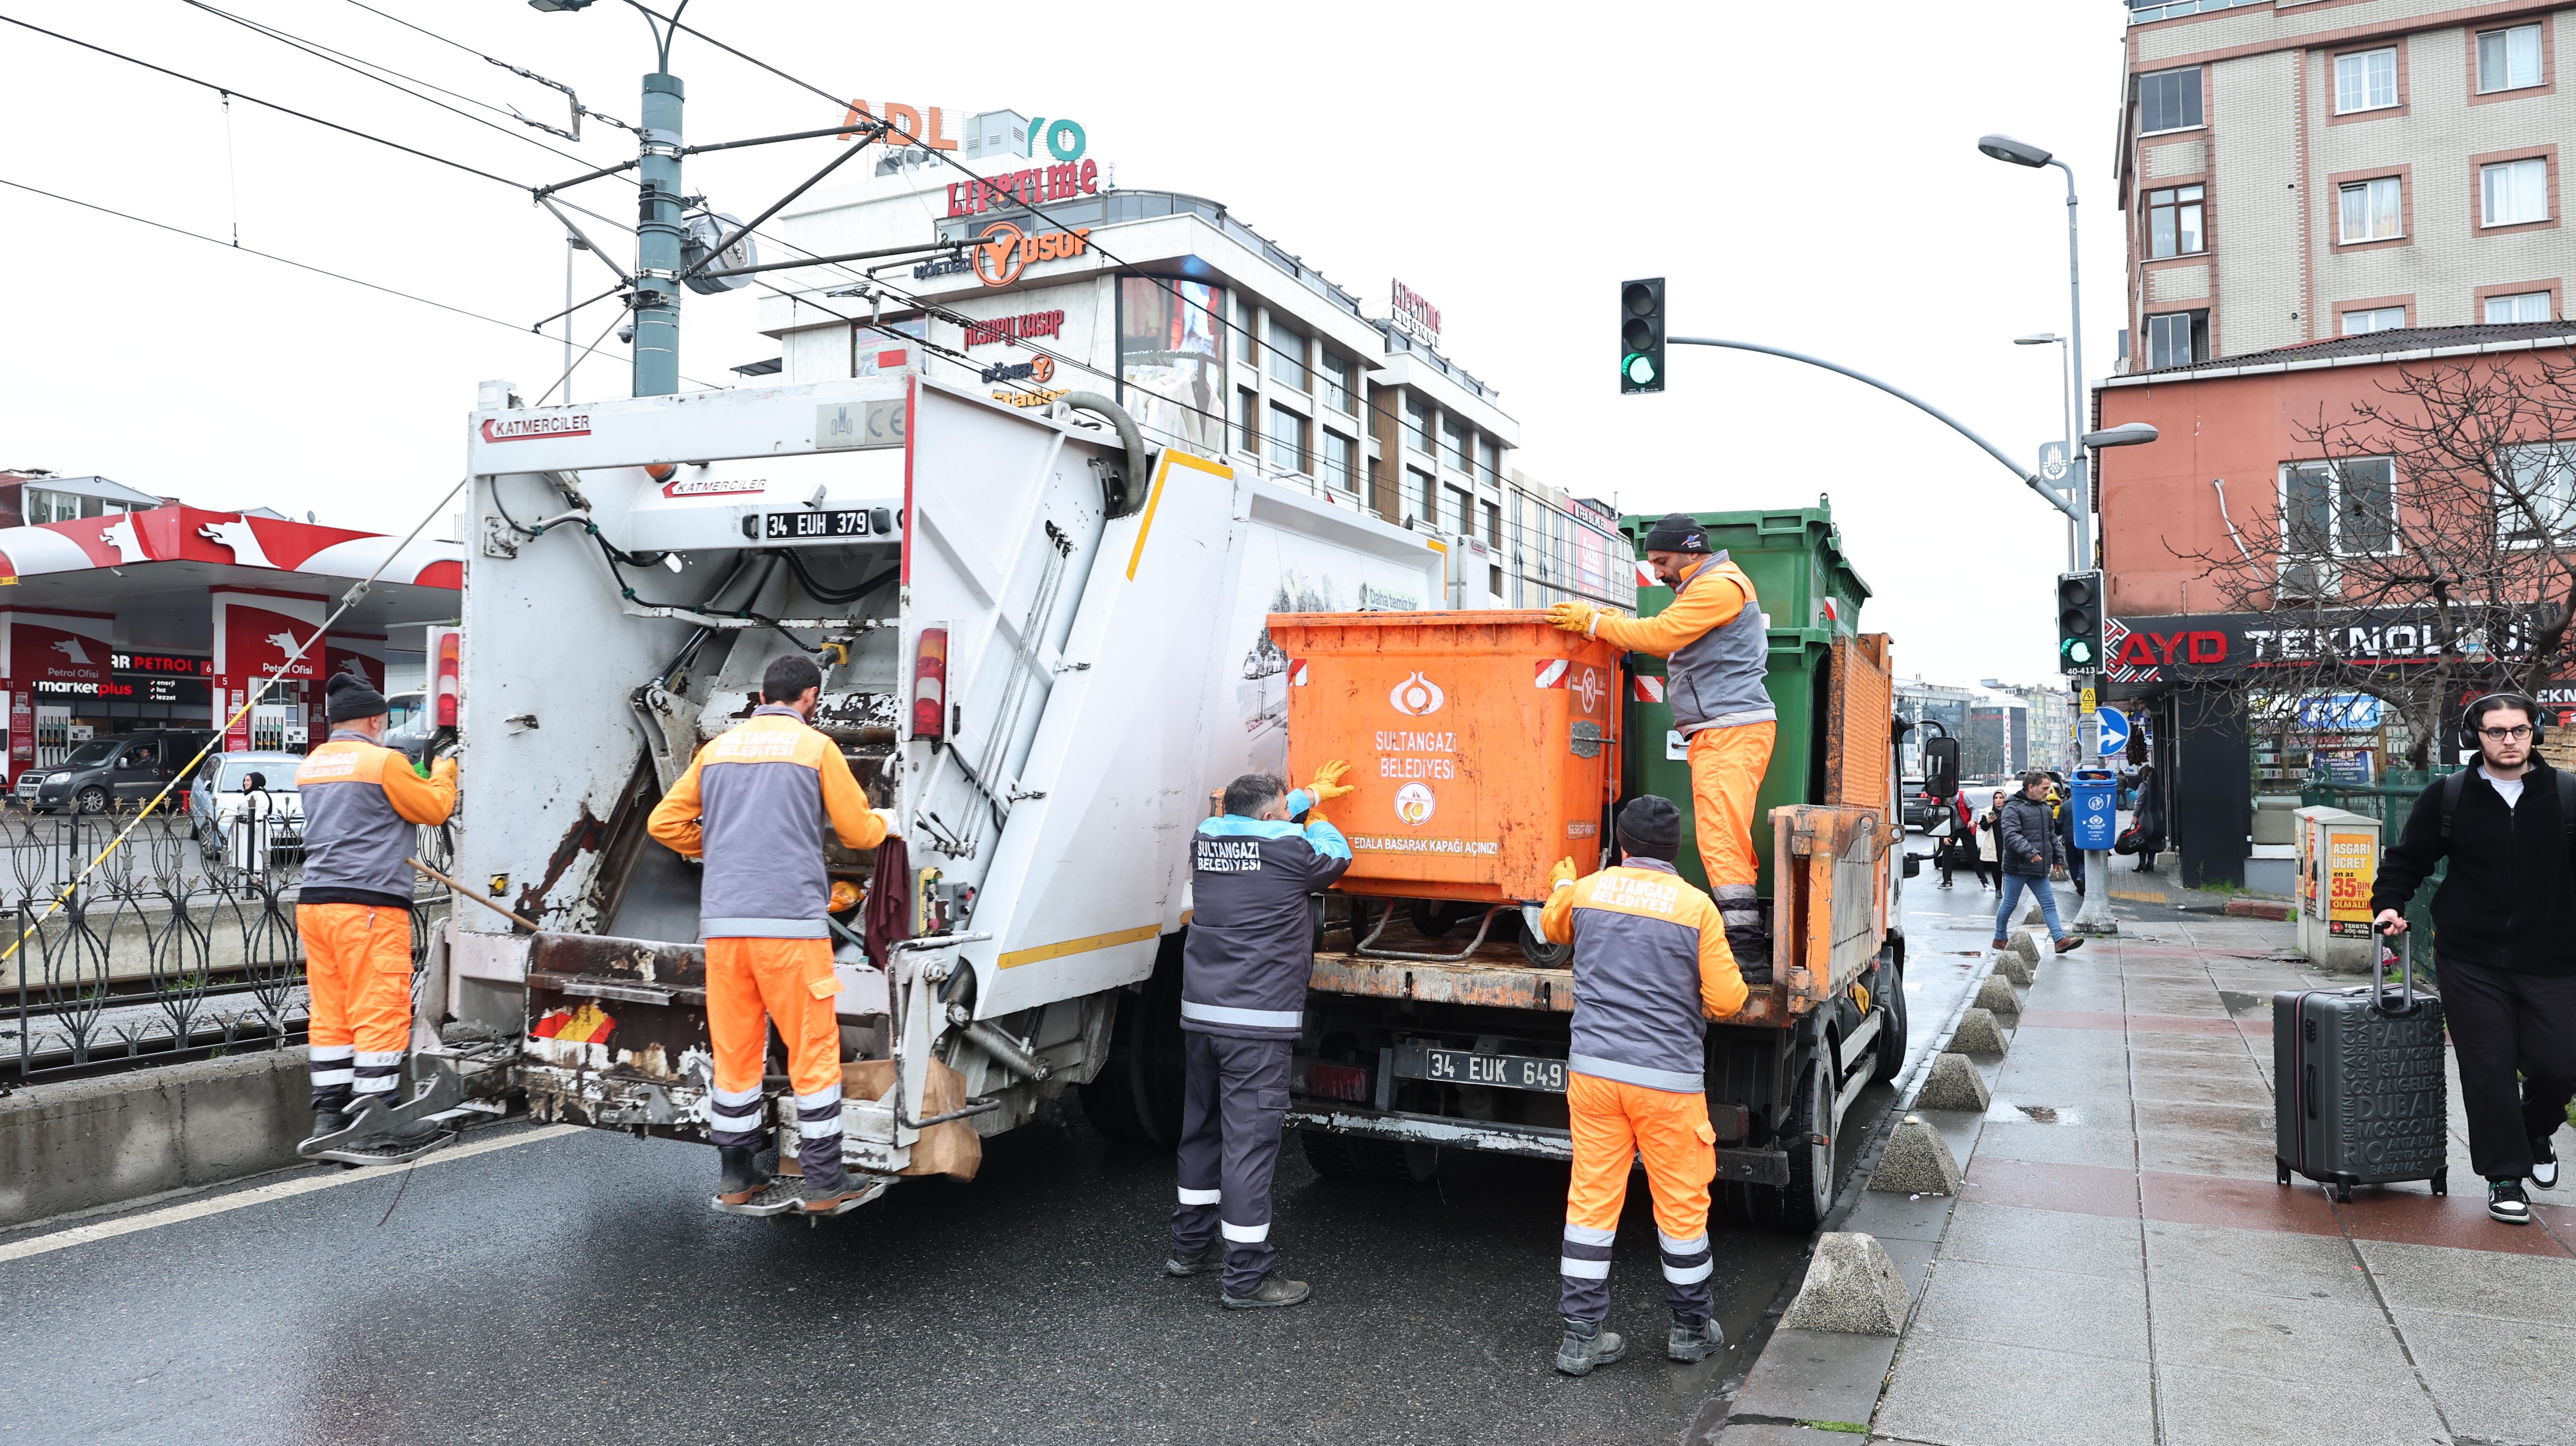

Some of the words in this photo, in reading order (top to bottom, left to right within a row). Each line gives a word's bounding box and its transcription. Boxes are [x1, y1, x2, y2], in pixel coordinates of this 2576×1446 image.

[837, 99, 957, 150] ADL
[983, 227, 1090, 277] YUSUF
[1018, 309, 1064, 339] KASAP
[768, 514, 788, 537] 34
[797, 512, 827, 535] EUH
[837, 510, 867, 533] 379
[1579, 507, 1588, 522] FEN
[1370, 588, 1388, 608] Daha
[1389, 594, 1408, 610] temiz
[1408, 597, 1418, 611] bir
[2117, 630, 2227, 665] AYD
[48, 667, 75, 677] Petrol
[77, 668, 99, 678] Ofisi
[111, 654, 130, 669] AR
[134, 656, 194, 673] PETROL
[206, 664, 211, 673] 6
[263, 662, 290, 674] Petrl
[291, 665, 313, 675] Ofisi
[2067, 667, 2096, 675] 40-413
[6, 680, 14, 688] 11
[156, 679, 176, 688] enerji
[222, 677, 228, 686] 5
[292, 683, 298, 691] 10
[2536, 689, 2576, 703] EKN
[1349, 836, 1383, 850] EDALA
[1385, 838, 1427, 852] BASARAK
[1429, 838, 1463, 853] KAPAĞI
[1466, 840, 1497, 857] AÇINIZ!
[2333, 841, 2371, 855] ASGARİ
[2332, 856, 2367, 869] ÜCRET
[2331, 877, 2357, 898] 35
[2357, 880, 2370, 890] BİN
[2357, 890, 2366, 898] TL
[2333, 900, 2368, 909] OLMALI!
[2371, 1019, 2433, 1049] PARIS
[2342, 1010, 2356, 1080] CANCUN
[2358, 1023, 2369, 1079] FLORIDA
[2371, 1048, 2399, 1063] NEW
[2402, 1046, 2434, 1061] YORK
[1431, 1054, 1456, 1078] 34
[1469, 1056, 1507, 1083] EUK
[1522, 1062, 1562, 1088] 649
[2342, 1080, 2371, 1096] LOS
[2375, 1075, 2437, 1094] ANGELES
[2358, 1091, 2435, 1121] DUBAI
[2342, 1096, 2355, 1142] BERLIN
[2357, 1116, 2437, 1140] MOSCOW
[2386, 1135, 2436, 1150] ANTALYA
[2342, 1140, 2384, 1166] RIO
[2388, 1150, 2417, 1162] PUNTA
[2370, 1160, 2424, 1177] BAHAMAS
